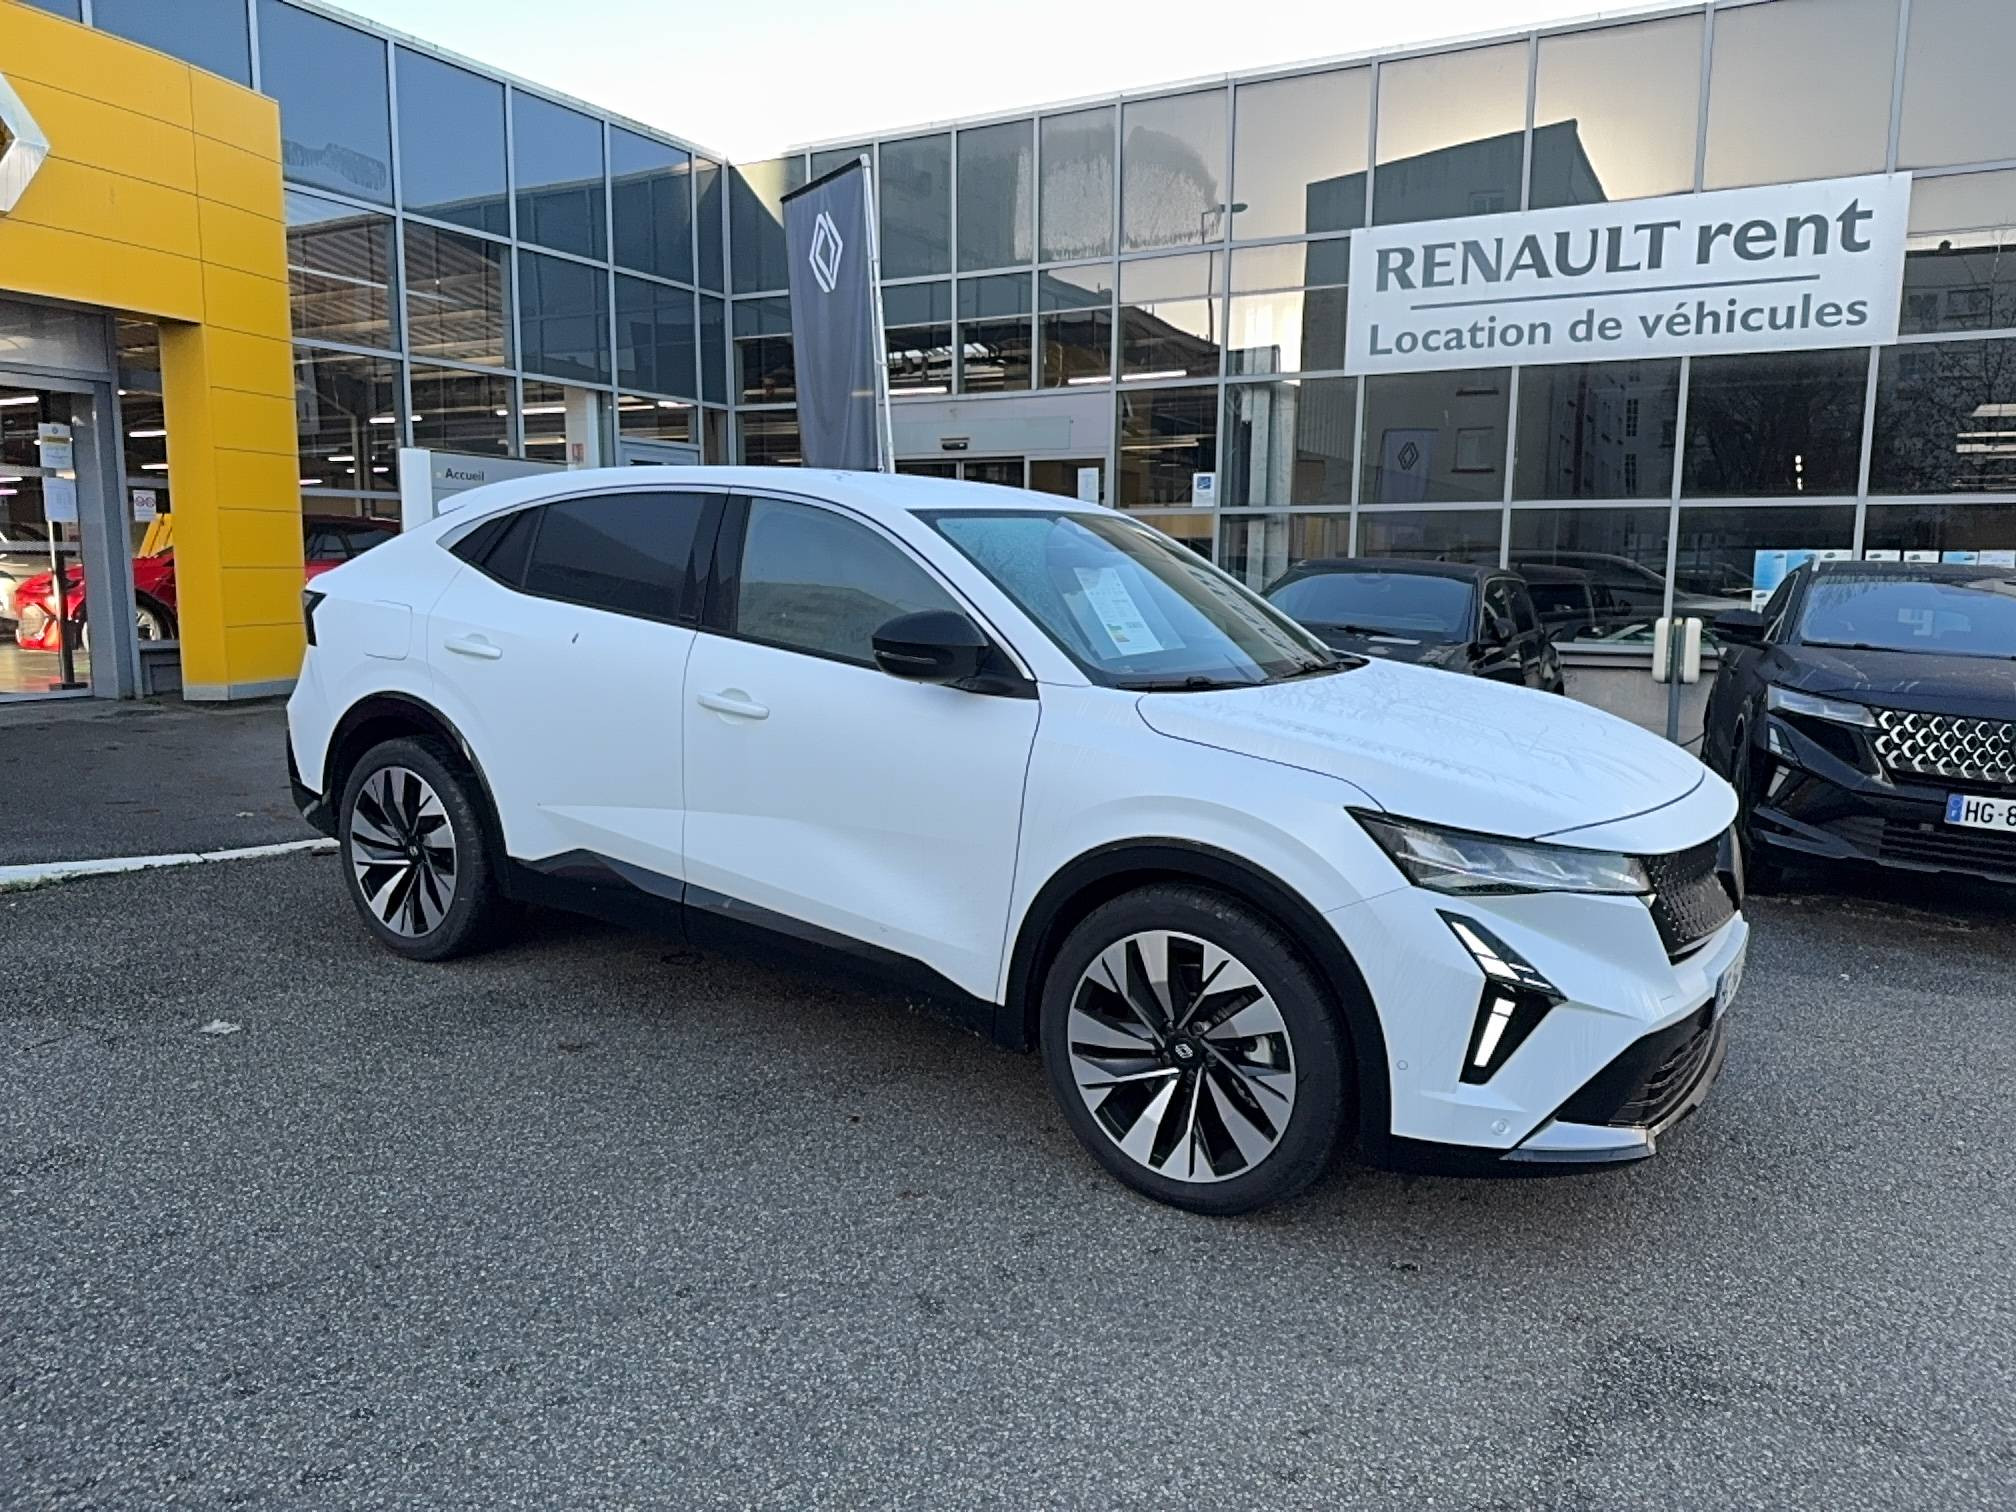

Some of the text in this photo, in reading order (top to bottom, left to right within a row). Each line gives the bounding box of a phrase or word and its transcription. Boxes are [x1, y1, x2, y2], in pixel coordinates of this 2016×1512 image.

[1376, 198, 1873, 292] RENAULT rent
[1369, 293, 1868, 356] Location de véhicules
[445, 467, 485, 481] Accueil
